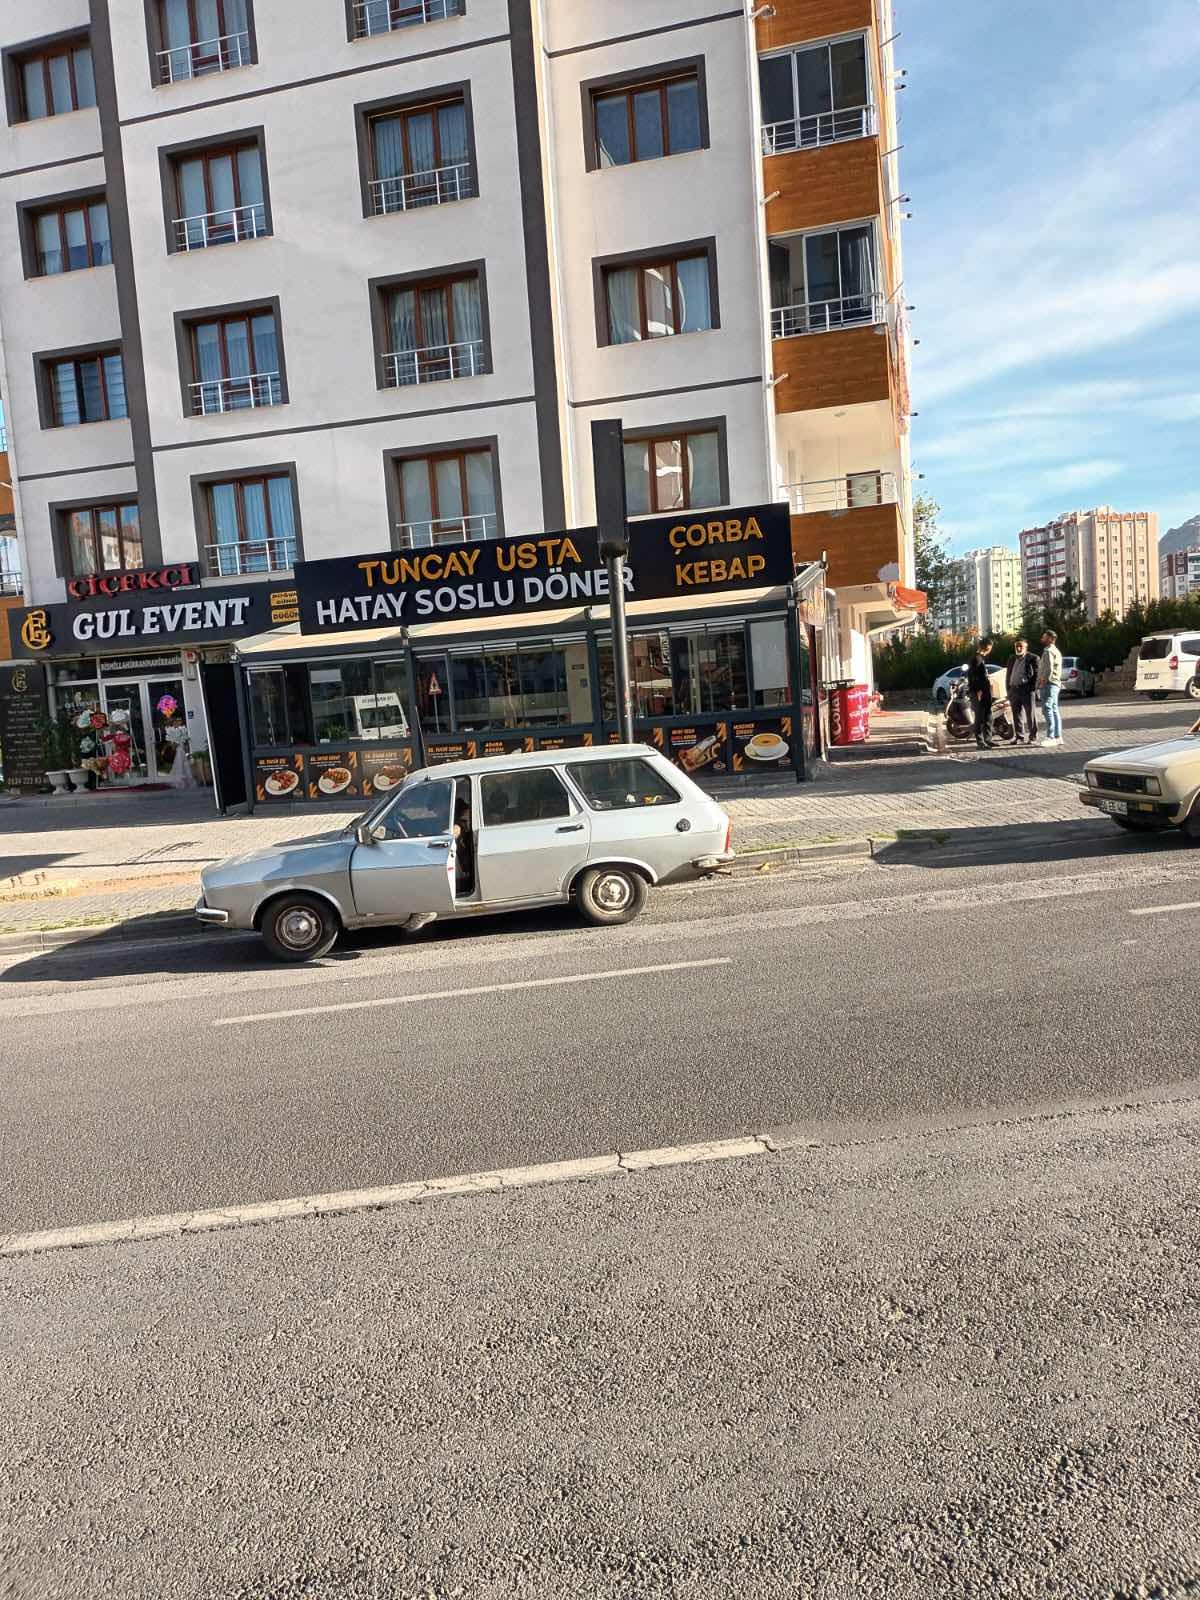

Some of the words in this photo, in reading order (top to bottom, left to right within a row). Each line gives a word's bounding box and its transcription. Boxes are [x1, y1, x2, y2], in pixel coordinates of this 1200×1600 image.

[669, 517, 764, 555] ÇORBA
[358, 548, 481, 587] TUNCAY
[496, 538, 582, 572] USTA
[675, 554, 766, 586] KEBAP
[316, 591, 407, 625] HATAY
[415, 579, 515, 614] SOSLU
[524, 566, 635, 603] DÖNER
[73, 609, 136, 640] GUL
[142, 597, 250, 634] EVENT
